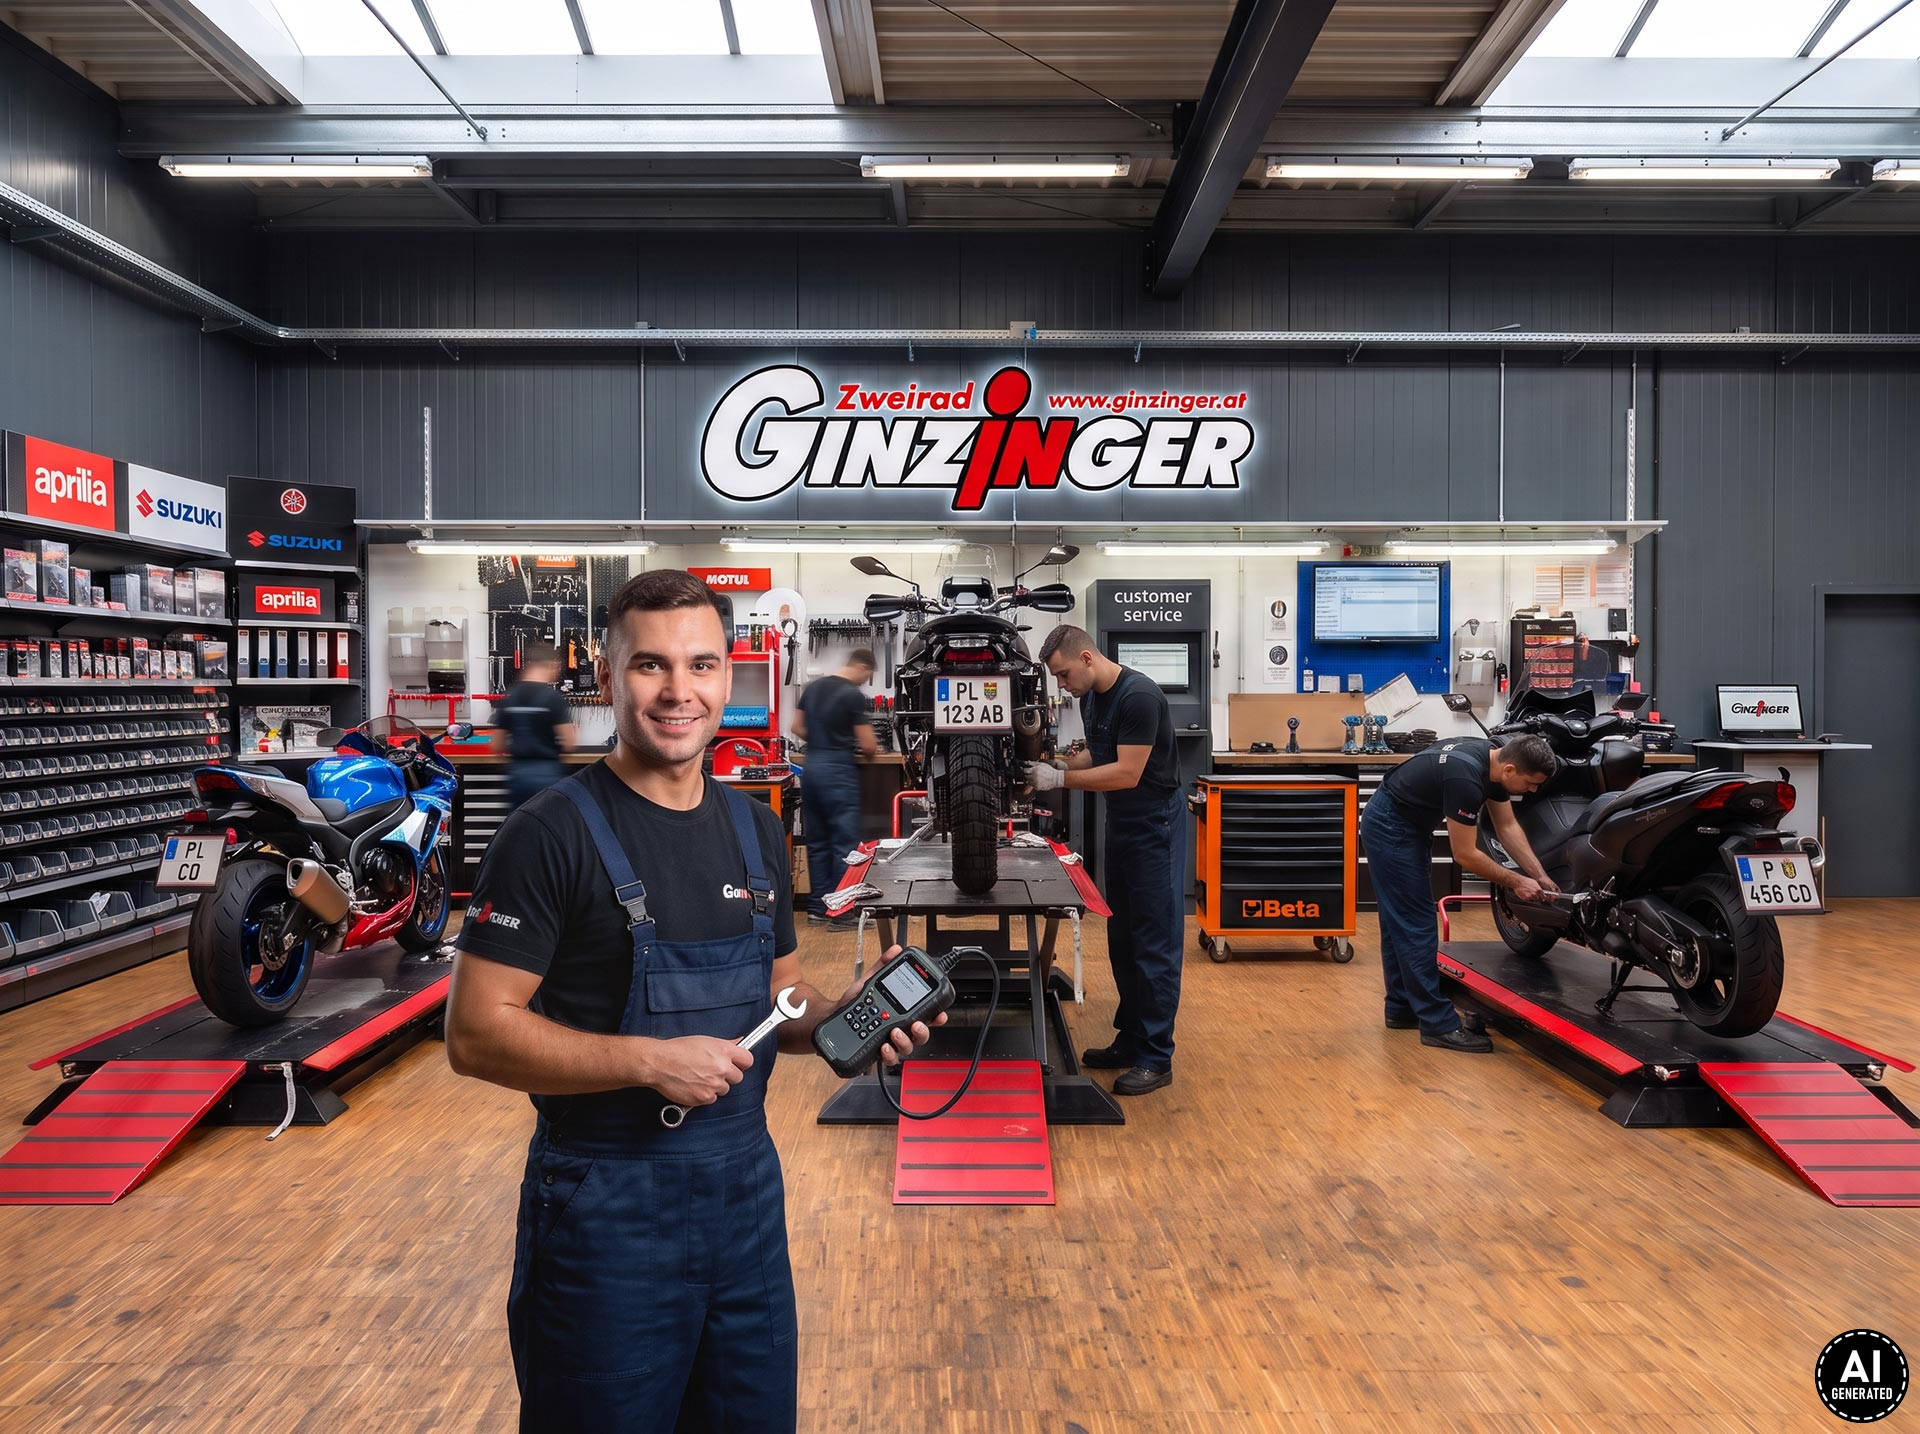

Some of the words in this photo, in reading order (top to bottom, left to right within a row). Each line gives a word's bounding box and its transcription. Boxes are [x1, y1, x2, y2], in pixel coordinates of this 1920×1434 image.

[835, 382, 975, 411] Zweirad
[1049, 389, 1247, 413] www.ginzinger.at
[34, 466, 107, 507] aprilia
[156, 498, 222, 529] SUZUKI
[268, 534, 342, 551] SUZUKI
[705, 574, 750, 586] MOTUL
[261, 590, 317, 609] aprilia
[1114, 589, 1193, 603] customer
[1123, 606, 1183, 622] service
[956, 681, 979, 701] PL
[943, 704, 975, 724] 123
[980, 704, 1004, 724] AB
[184, 841, 204, 859] PL
[1762, 860, 1774, 880] P
[1750, 884, 1784, 904] 456
[1787, 884, 1812, 904] CD
[1263, 899, 1320, 918] Beta
